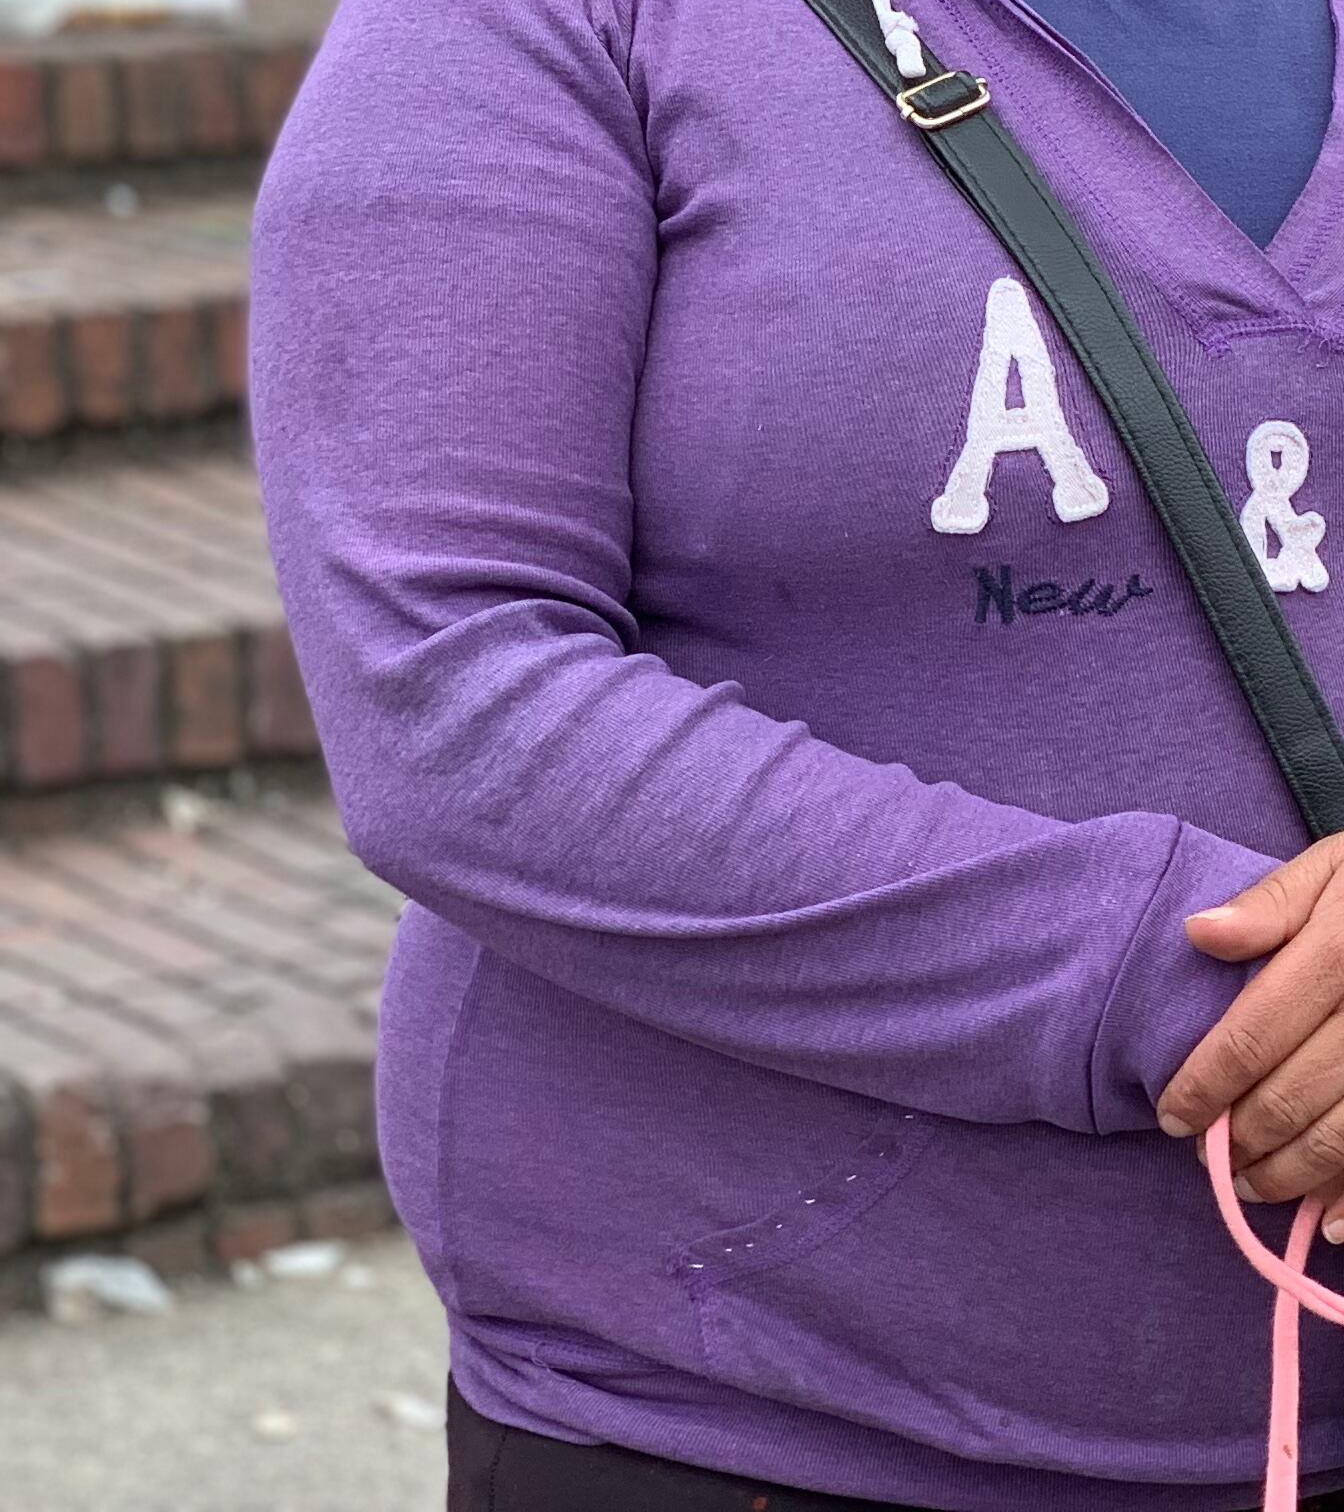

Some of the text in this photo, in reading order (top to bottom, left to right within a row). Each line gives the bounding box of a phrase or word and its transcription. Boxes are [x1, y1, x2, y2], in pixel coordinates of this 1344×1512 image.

[930, 276, 1109, 534] A
[1240, 420, 1329, 592] &
[972, 564, 1154, 625] New
